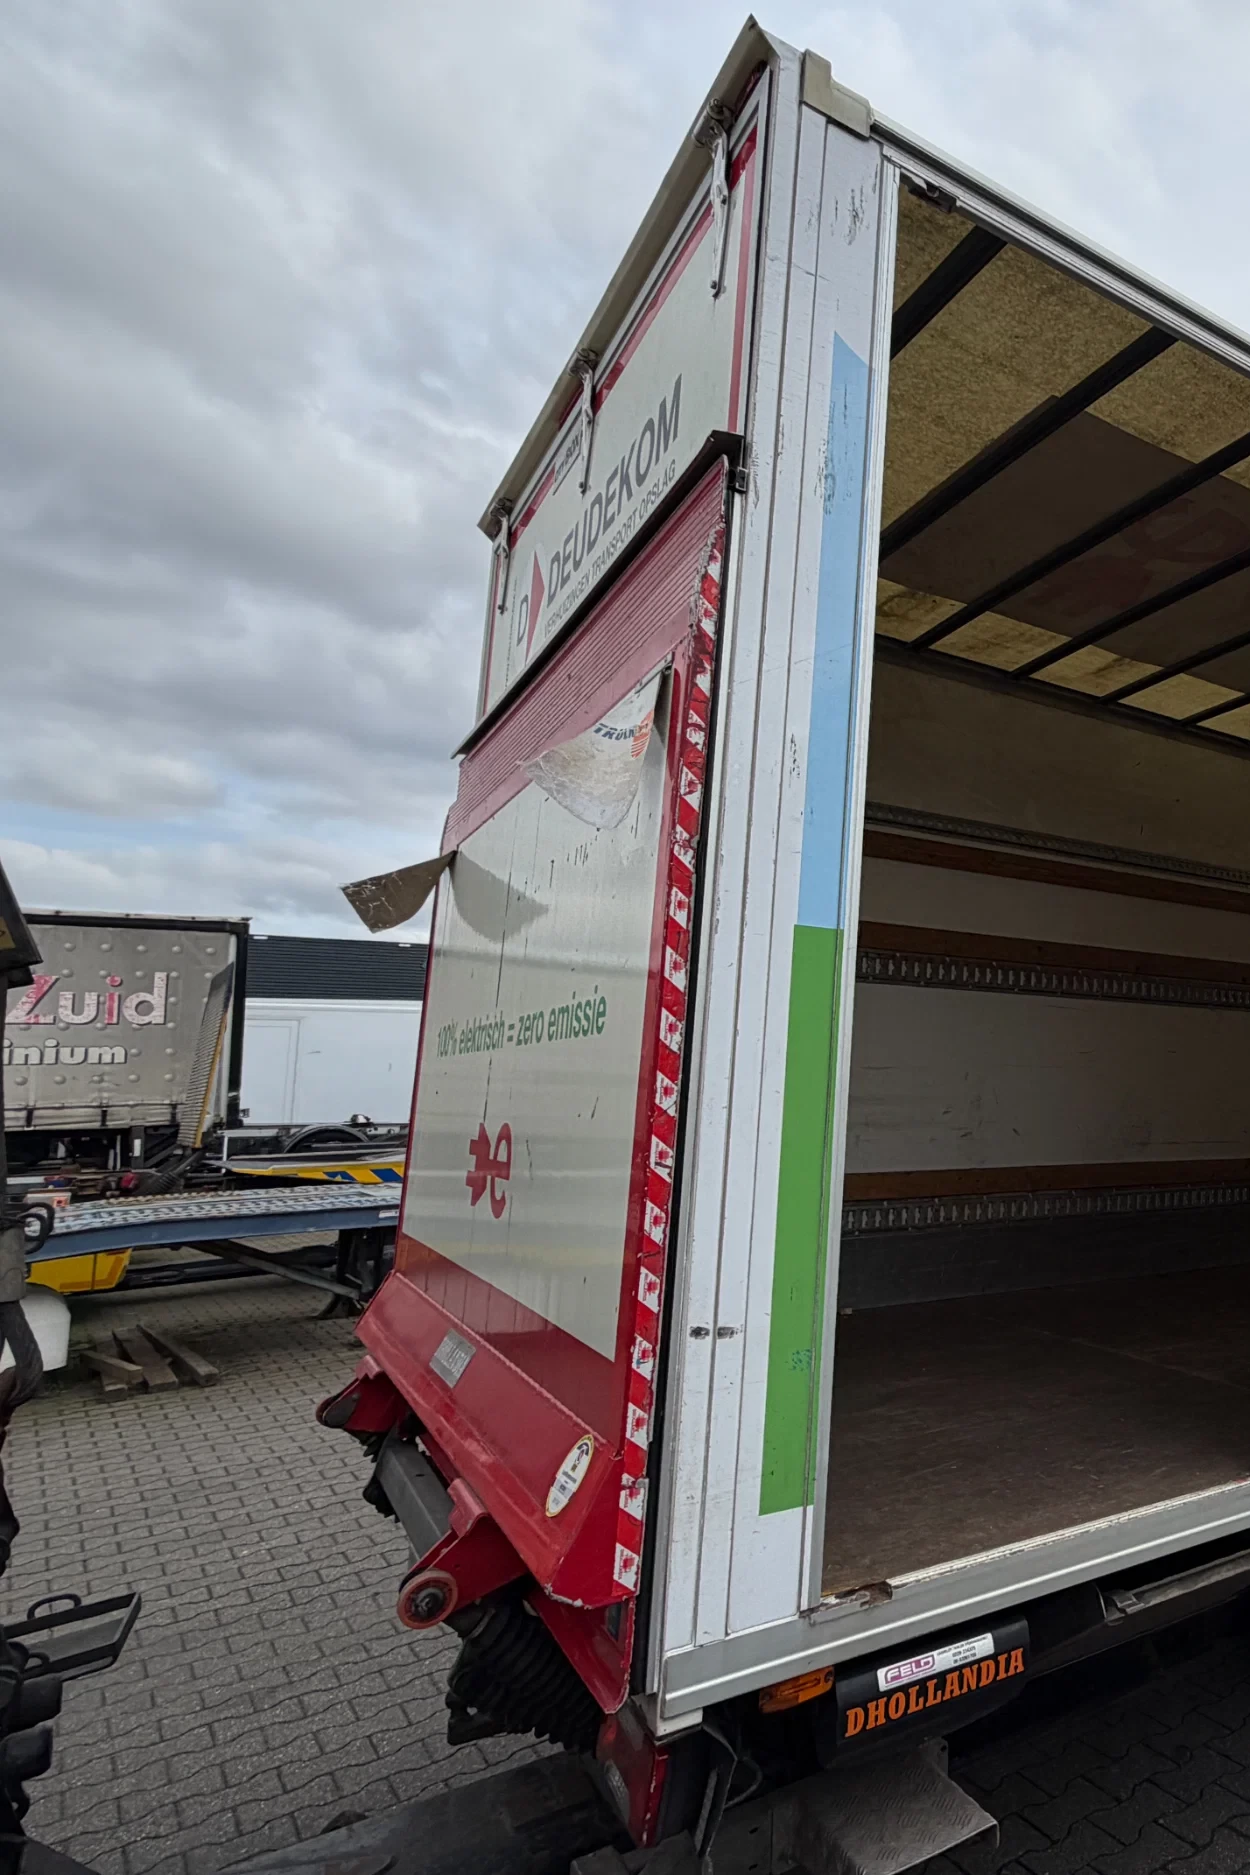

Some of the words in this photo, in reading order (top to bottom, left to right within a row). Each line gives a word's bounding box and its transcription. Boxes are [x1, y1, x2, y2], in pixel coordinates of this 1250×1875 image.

[547, 373, 683, 608] DEUDEKOM
[592, 507, 638, 580] TRANSPORT
[639, 458, 676, 520] OPSLAG
[517, 593, 529, 647] D
[5, 971, 169, 1025] Zuid
[436, 1017, 458, 1058] 100%
[458, 1010, 506, 1056] elektrisch
[515, 1010, 545, 1047] zero
[547, 984, 608, 1042] emissie
[844, 1647, 1025, 1738] DHOLLANDIA
[886, 1655, 935, 1684] FELD
